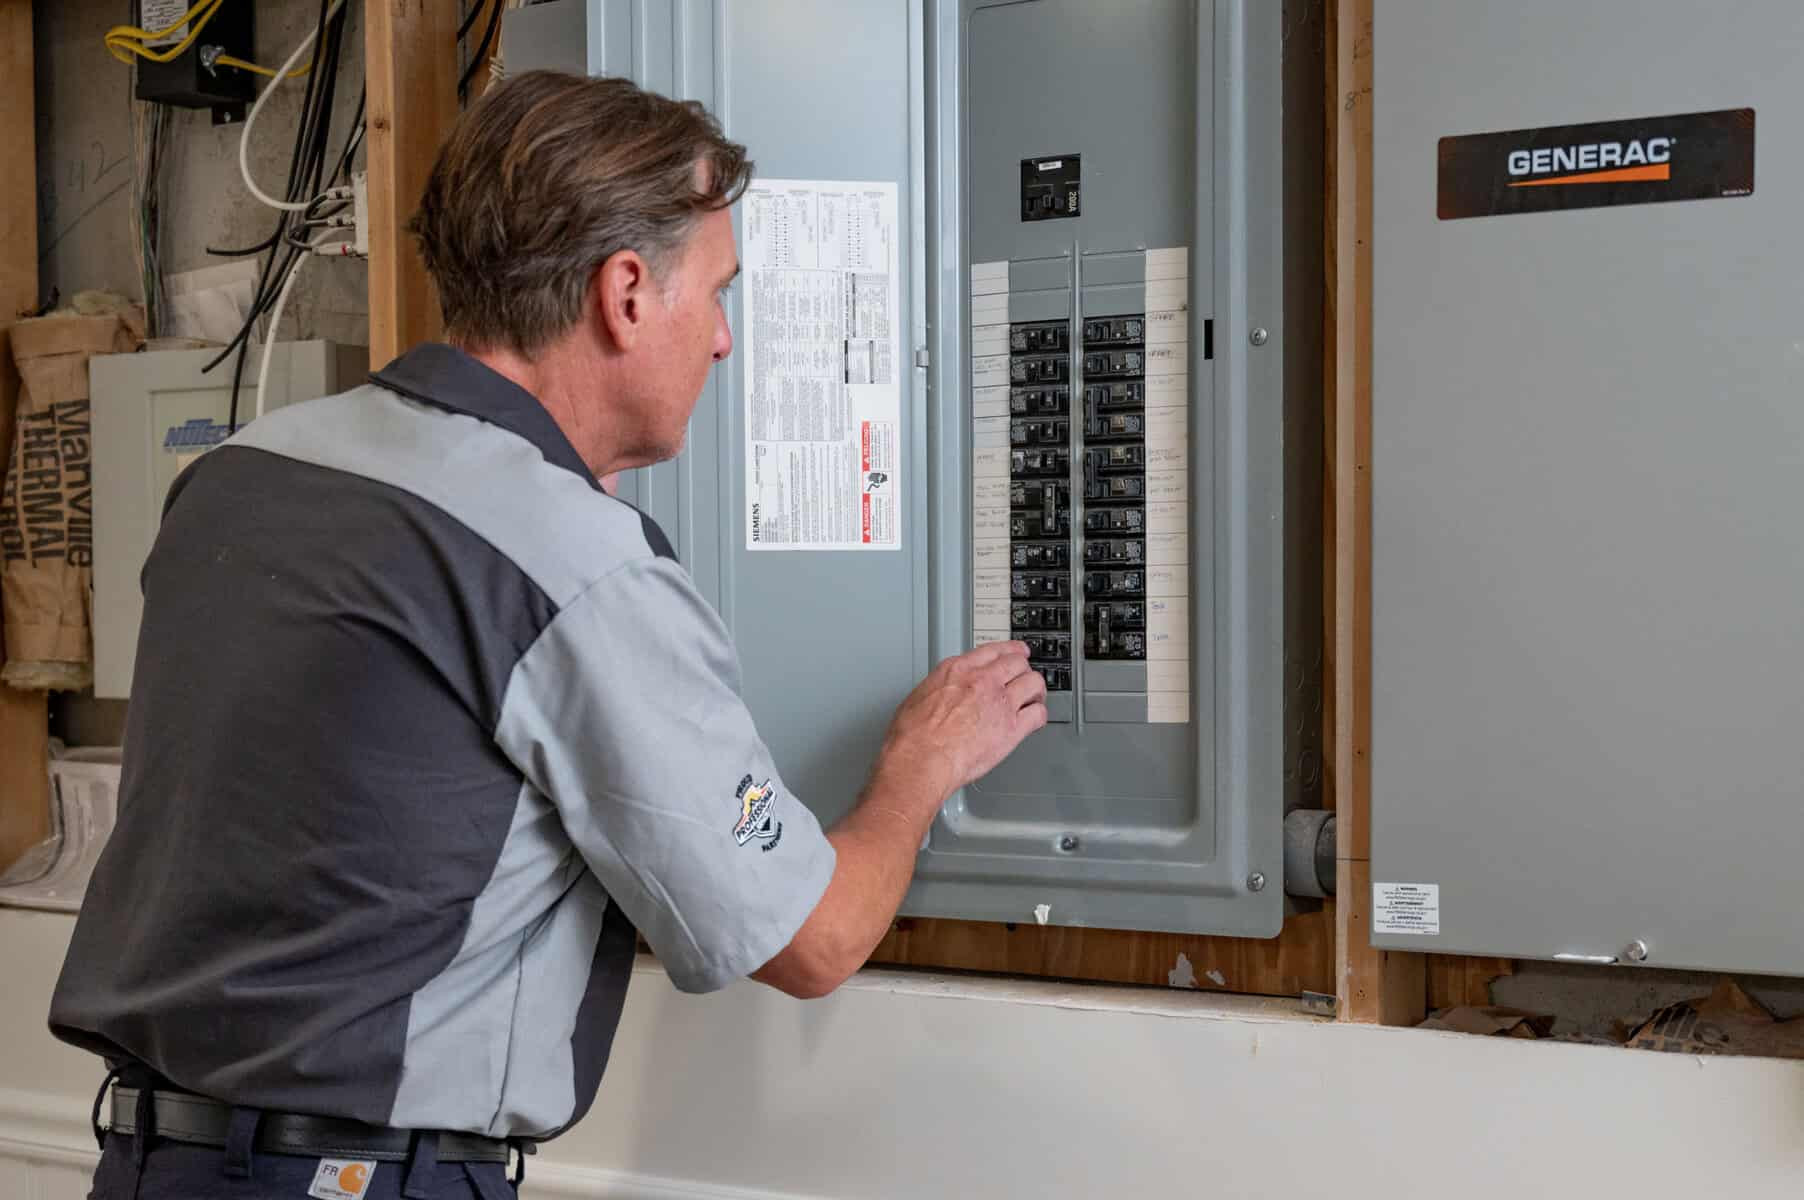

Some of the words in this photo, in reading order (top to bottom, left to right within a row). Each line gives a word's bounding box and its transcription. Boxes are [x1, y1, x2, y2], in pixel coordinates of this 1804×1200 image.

[1507, 137, 1670, 176] GENERAC
[21, 403, 65, 569] THERMAL
[322, 1164, 338, 1176] FR
